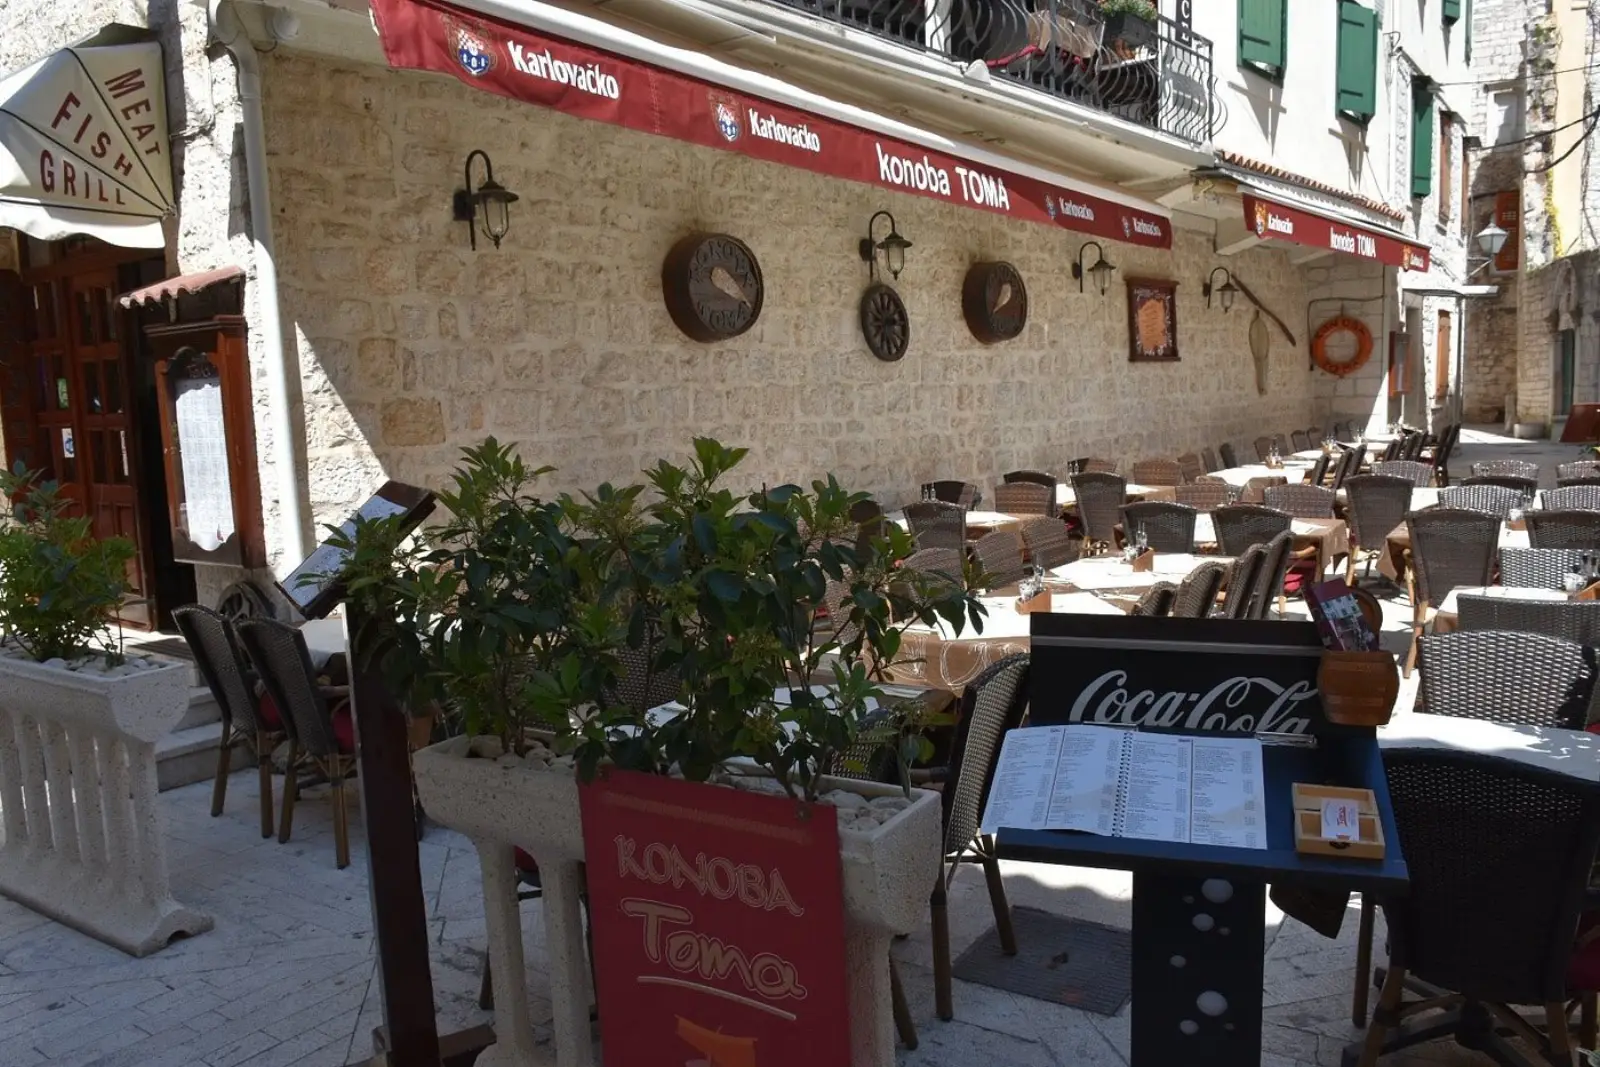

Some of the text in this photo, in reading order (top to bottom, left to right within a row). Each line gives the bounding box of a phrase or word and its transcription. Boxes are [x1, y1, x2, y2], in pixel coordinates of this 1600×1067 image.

[507, 40, 620, 100] Karlovačko
[51, 92, 133, 177] FISH
[104, 68, 162, 157] MEAT
[748, 108, 820, 153] Karlovačko
[40, 149, 127, 206] GRILL
[876, 142, 1010, 212] konoba TOMA
[1356, 233, 1377, 258] TOMA
[1069, 669, 1319, 736] Coca-Cola
[614, 835, 805, 917] KONOBA
[620, 898, 808, 1000] Toma
